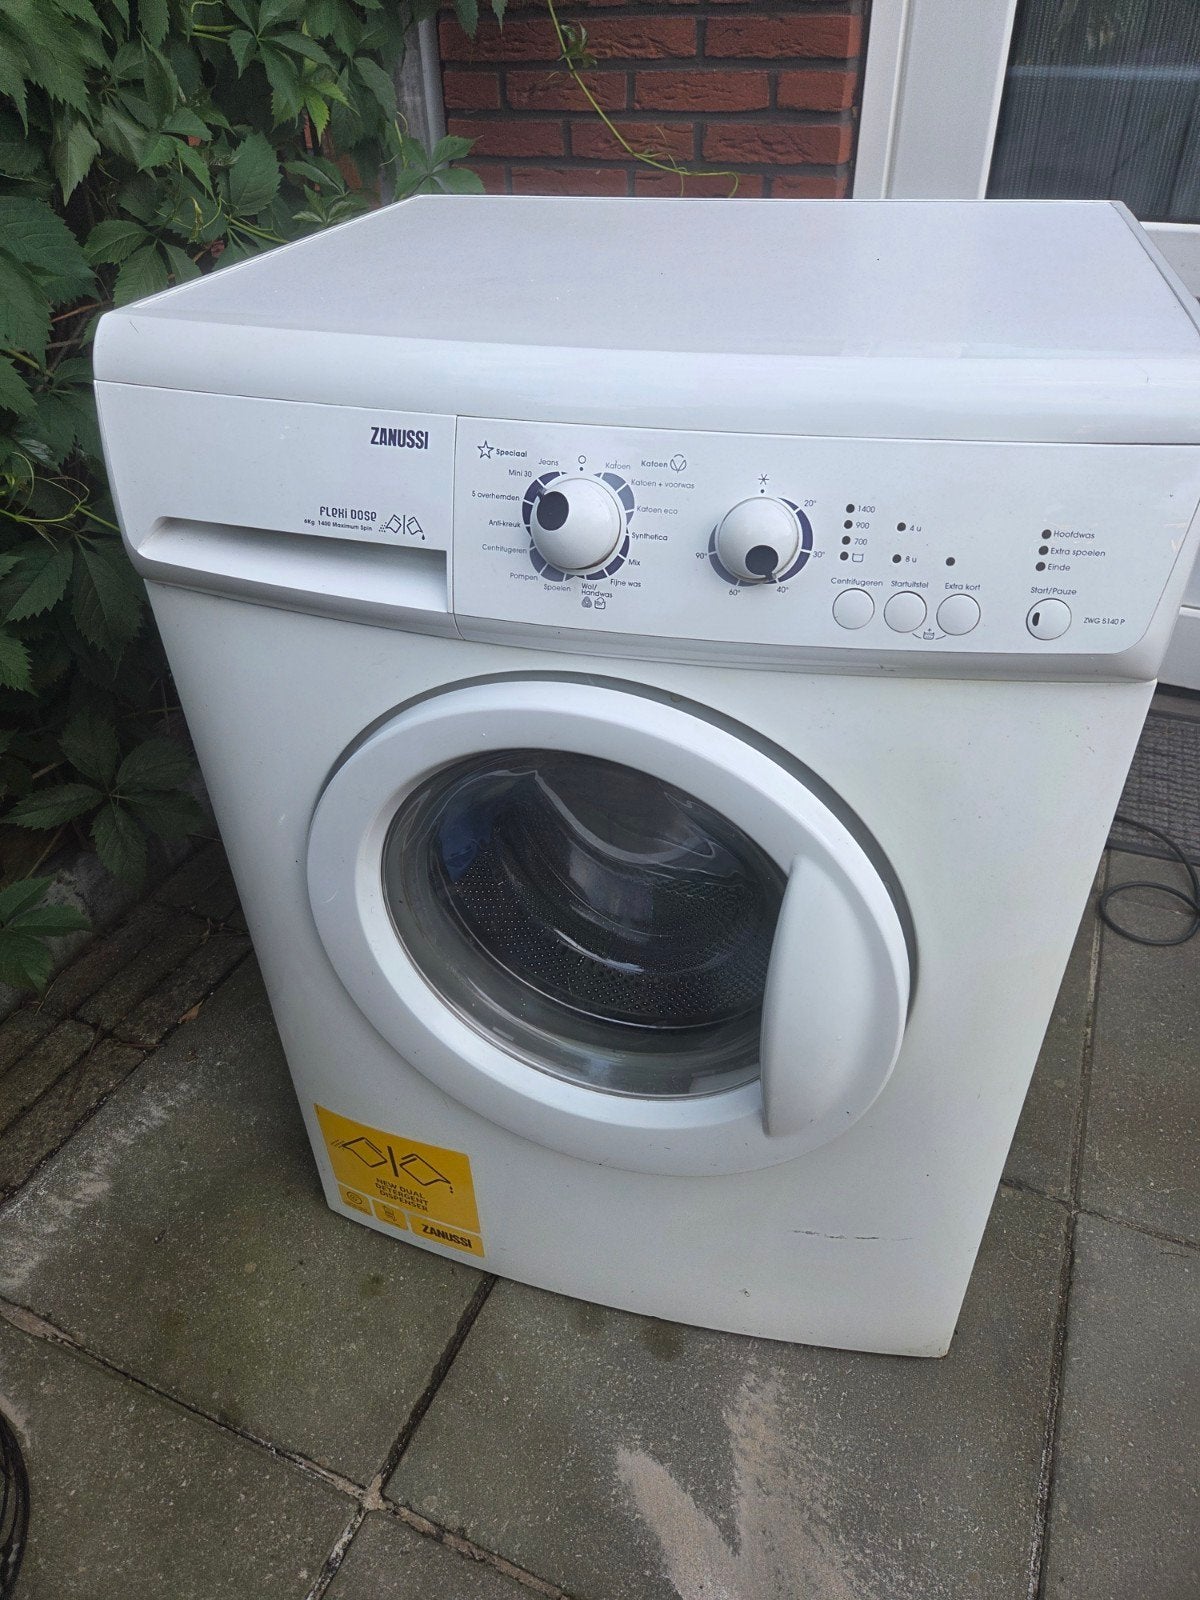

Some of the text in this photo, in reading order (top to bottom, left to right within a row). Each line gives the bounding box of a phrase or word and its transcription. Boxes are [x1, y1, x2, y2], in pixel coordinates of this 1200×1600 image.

[370, 426, 429, 450] ZANUSSI
[496, 448, 528, 458] Speciaal
[538, 458, 559, 467] Jeans
[605, 461, 631, 470] Katoen
[640, 460, 669, 468] Katoen
[508, 469, 533, 478] Mini 30
[477, 492, 520, 501] overhemden
[804, 499, 817, 507] 20°
[636, 506, 662, 515] Katoen
[858, 505, 876, 514] 1400
[317, 520, 331, 528] 1400
[332, 521, 359, 530] Maximum
[360, 524, 373, 532] Spin
[488, 519, 521, 529] Anti-kreuk
[855, 521, 870, 530] 900
[909, 525, 915, 533] 4
[631, 532, 668, 542] Synthetica
[1053, 530, 1096, 540] Hoofdwas
[854, 538, 868, 547] 700
[481, 543, 528, 554] Centrifugeren
[1050, 547, 1106, 557] Extra spoelen
[695, 552, 708, 560] 90°
[905, 555, 911, 563] 8
[1047, 563, 1071, 572] Einde
[509, 572, 538, 582] Pompen
[830, 577, 884, 587] Centrifugeren
[890, 580, 929, 590] Startuitstel
[944, 582, 981, 591] Extra kort
[581, 590, 613, 598] Handwas
[728, 589, 741, 597] 60°
[1030, 586, 1077, 596] Start/Pauze
[1083, 617, 1101, 625] ZWG
[375, 1177, 425, 1200] NEW DUAL
[375, 1182, 429, 1207] DETERGENT
[379, 1190, 429, 1213] DISPENSER
[421, 1223, 473, 1249] ZANUSSI
